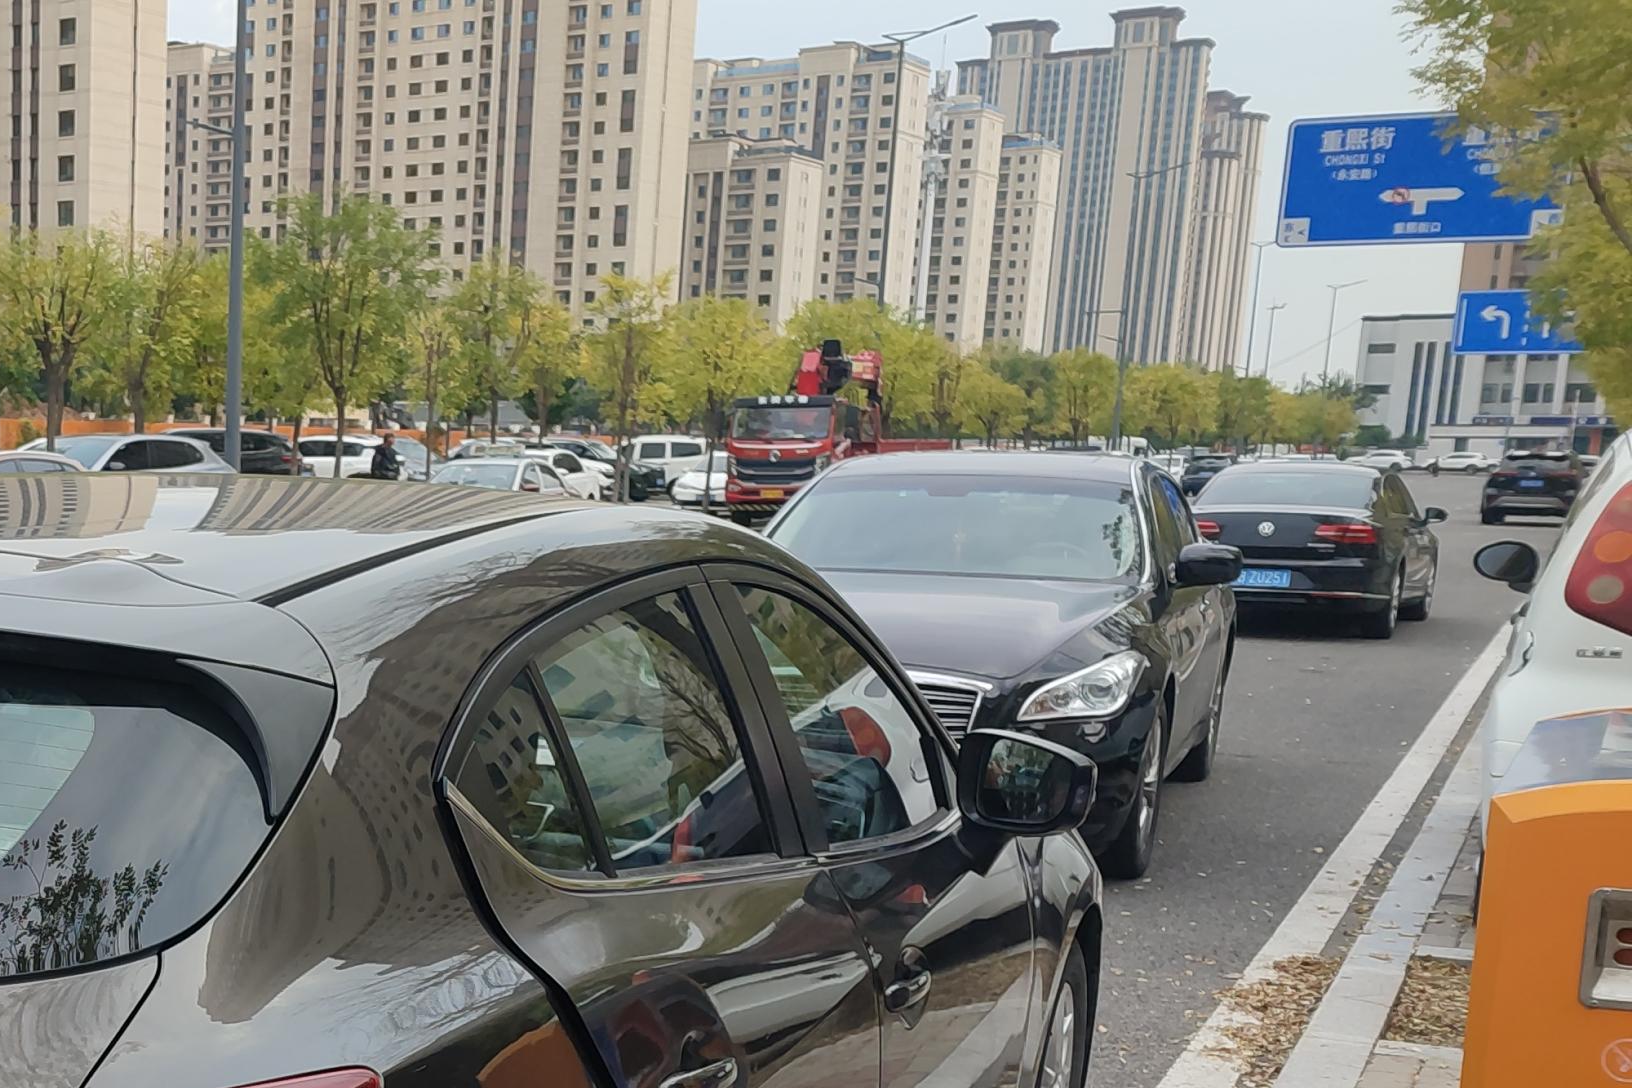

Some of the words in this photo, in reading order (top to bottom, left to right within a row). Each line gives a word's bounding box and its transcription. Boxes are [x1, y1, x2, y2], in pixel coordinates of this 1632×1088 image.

[1319, 127, 1396, 153] 重熙街
[1324, 153, 1369, 167] CHONGXI
